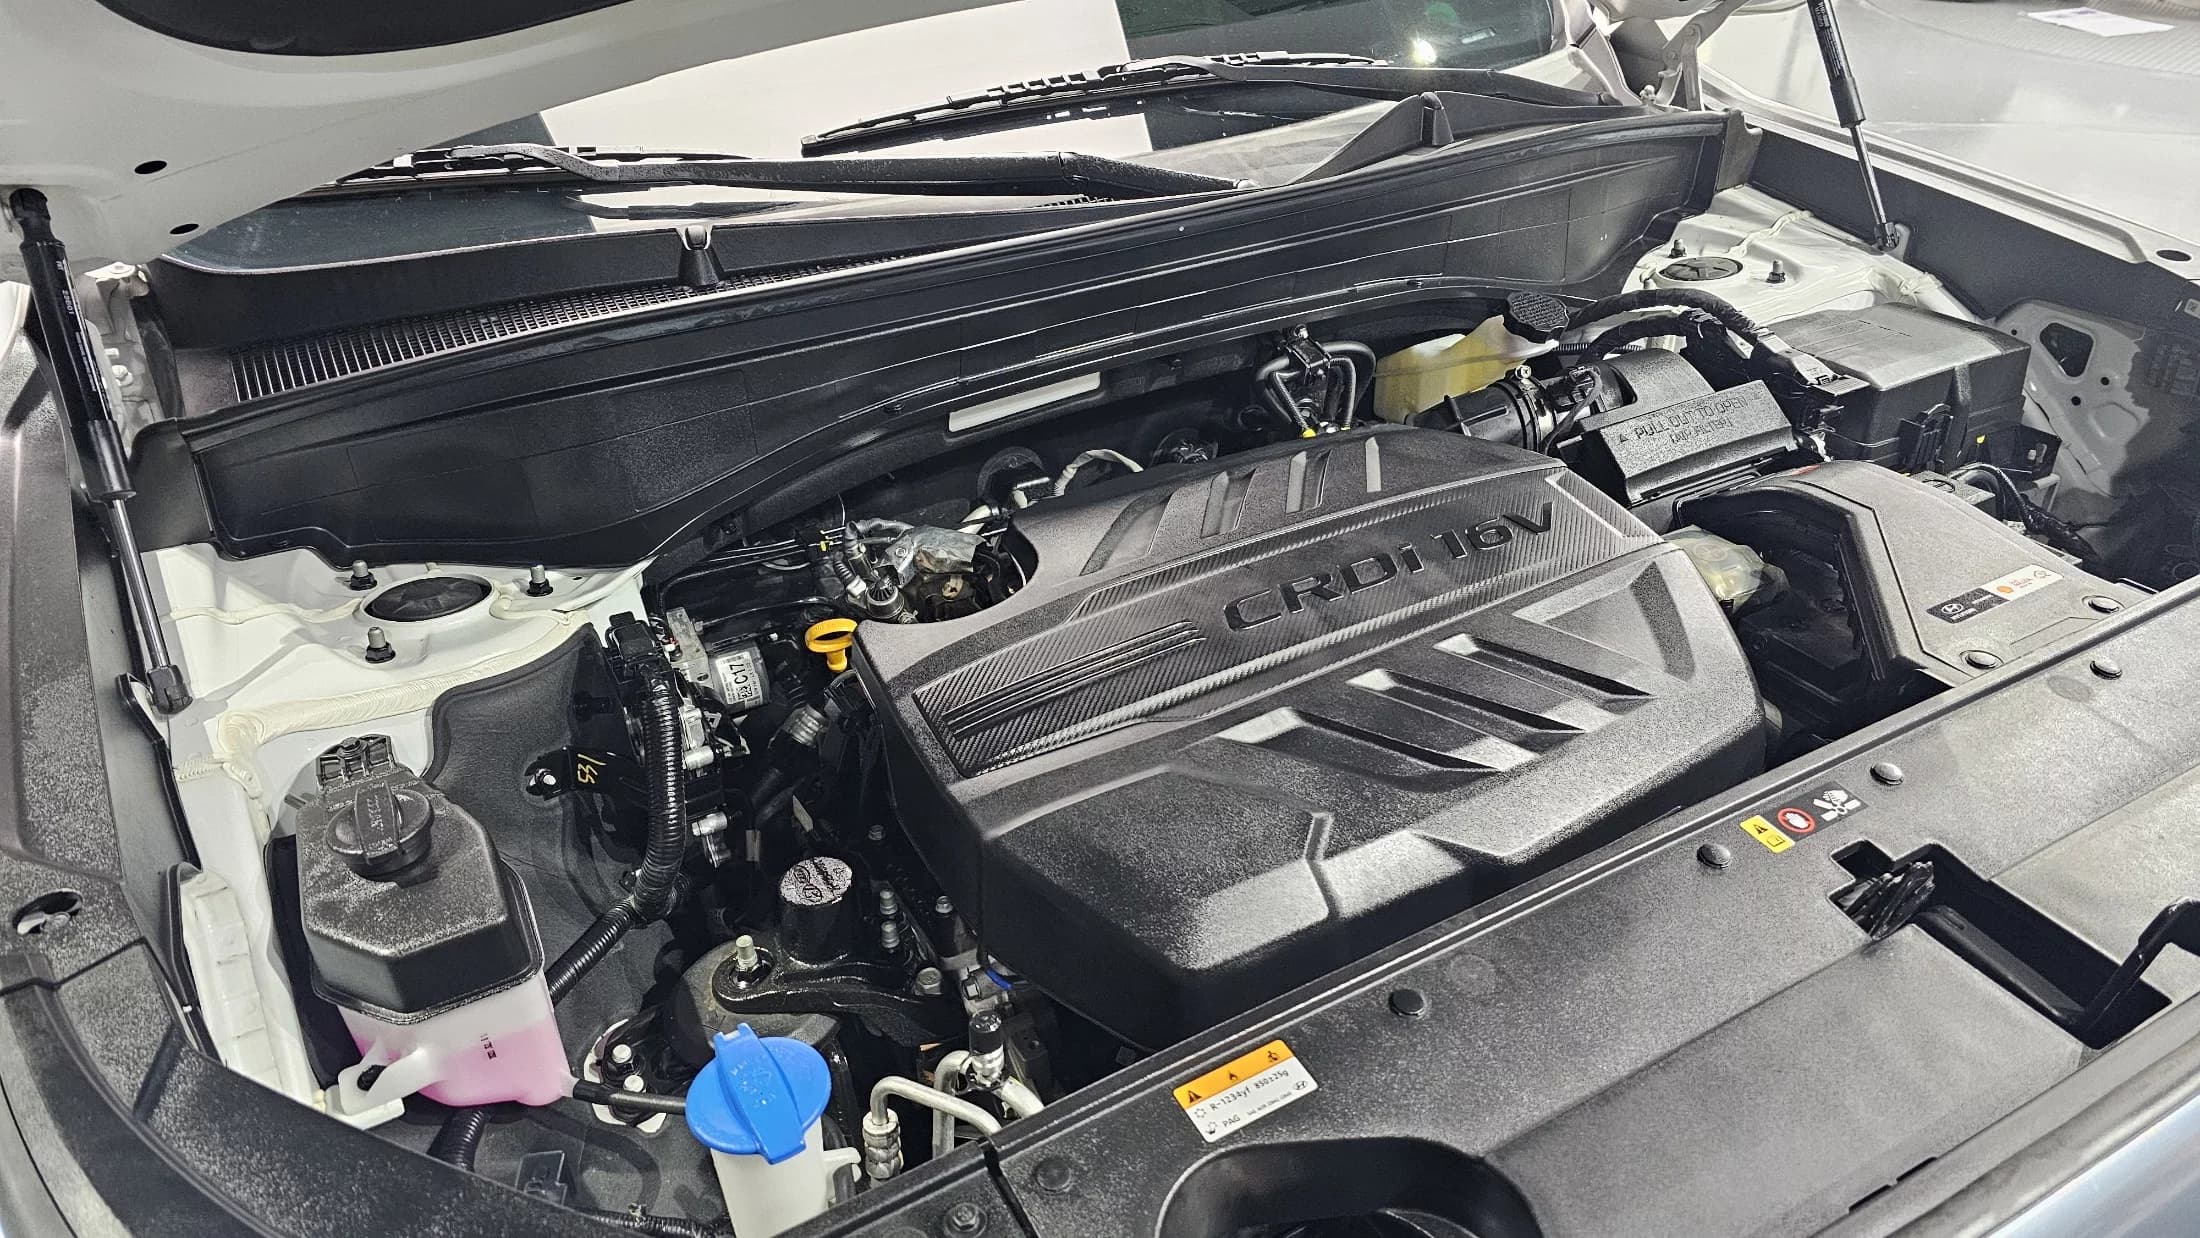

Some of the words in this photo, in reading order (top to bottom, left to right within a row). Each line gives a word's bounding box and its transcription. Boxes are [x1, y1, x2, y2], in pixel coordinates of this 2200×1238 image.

[1634, 420, 1670, 439] PULL
[1669, 410, 1695, 428] OUT
[1695, 405, 1715, 420] TO
[1714, 395, 1749, 415] OPEN
[1223, 543, 1425, 631] CRDi
[1430, 501, 1554, 560] 16V
[729, 663, 749, 685] C17
[1210, 1086, 1251, 1112] R-1234yf
[1222, 1114, 1241, 1128] PAG
